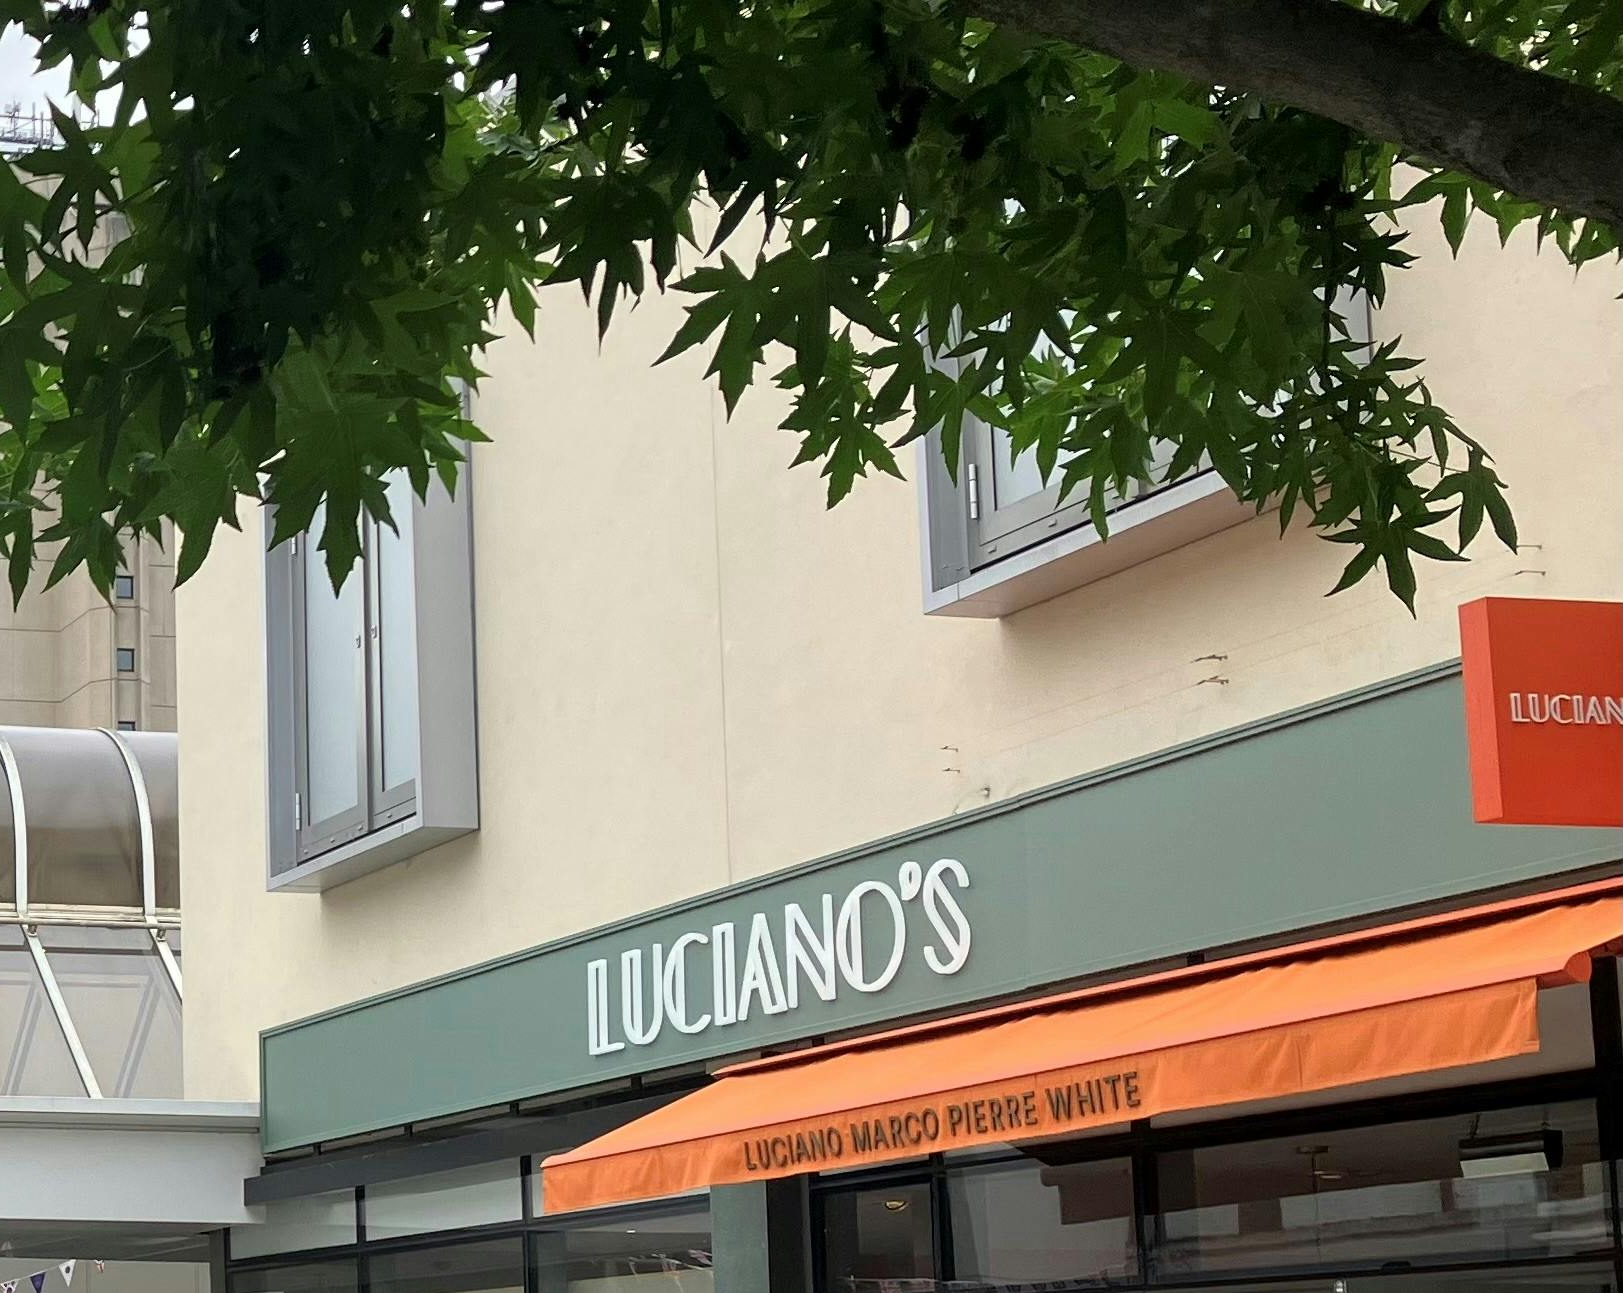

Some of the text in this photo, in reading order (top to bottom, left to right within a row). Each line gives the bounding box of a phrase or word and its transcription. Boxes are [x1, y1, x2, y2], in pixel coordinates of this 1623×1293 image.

[1509, 692, 1623, 725] LUCIAN
[587, 858, 972, 1056] LUCIANO'S
[744, 1071, 1142, 1171] LUCIANO MARCO PIERRE WHITE
